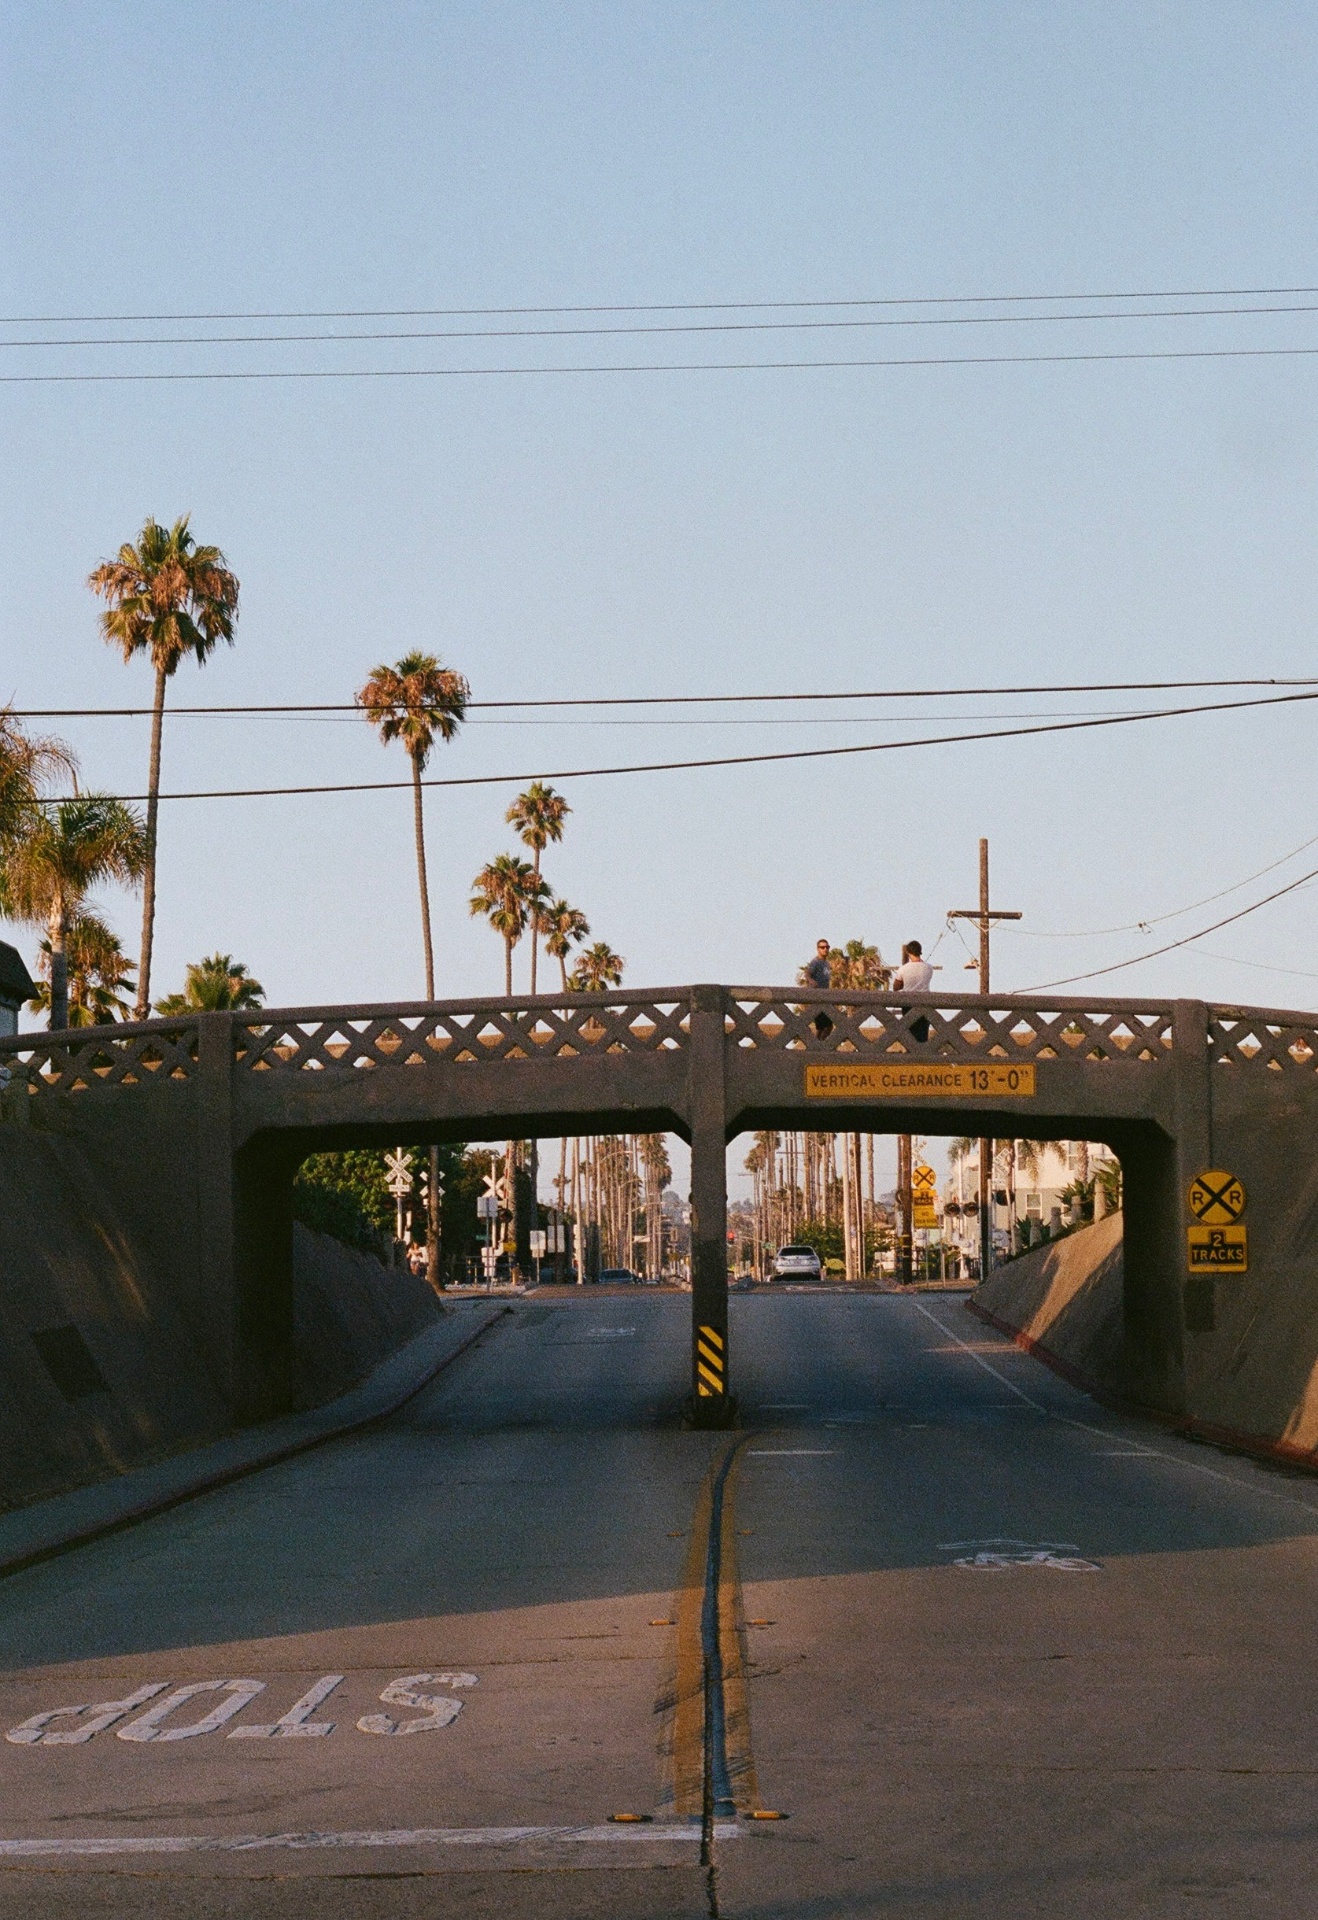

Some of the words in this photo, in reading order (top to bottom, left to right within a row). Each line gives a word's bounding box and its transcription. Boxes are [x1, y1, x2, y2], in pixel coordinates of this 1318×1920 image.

[811, 1074, 876, 1088] VERTICAL
[882, 1073, 962, 1087] CLEARANCE
[1213, 1234, 1222, 1247] 2
[1192, 1249, 1243, 1260] TRACKS
[5, 1671, 480, 1744] STOP
